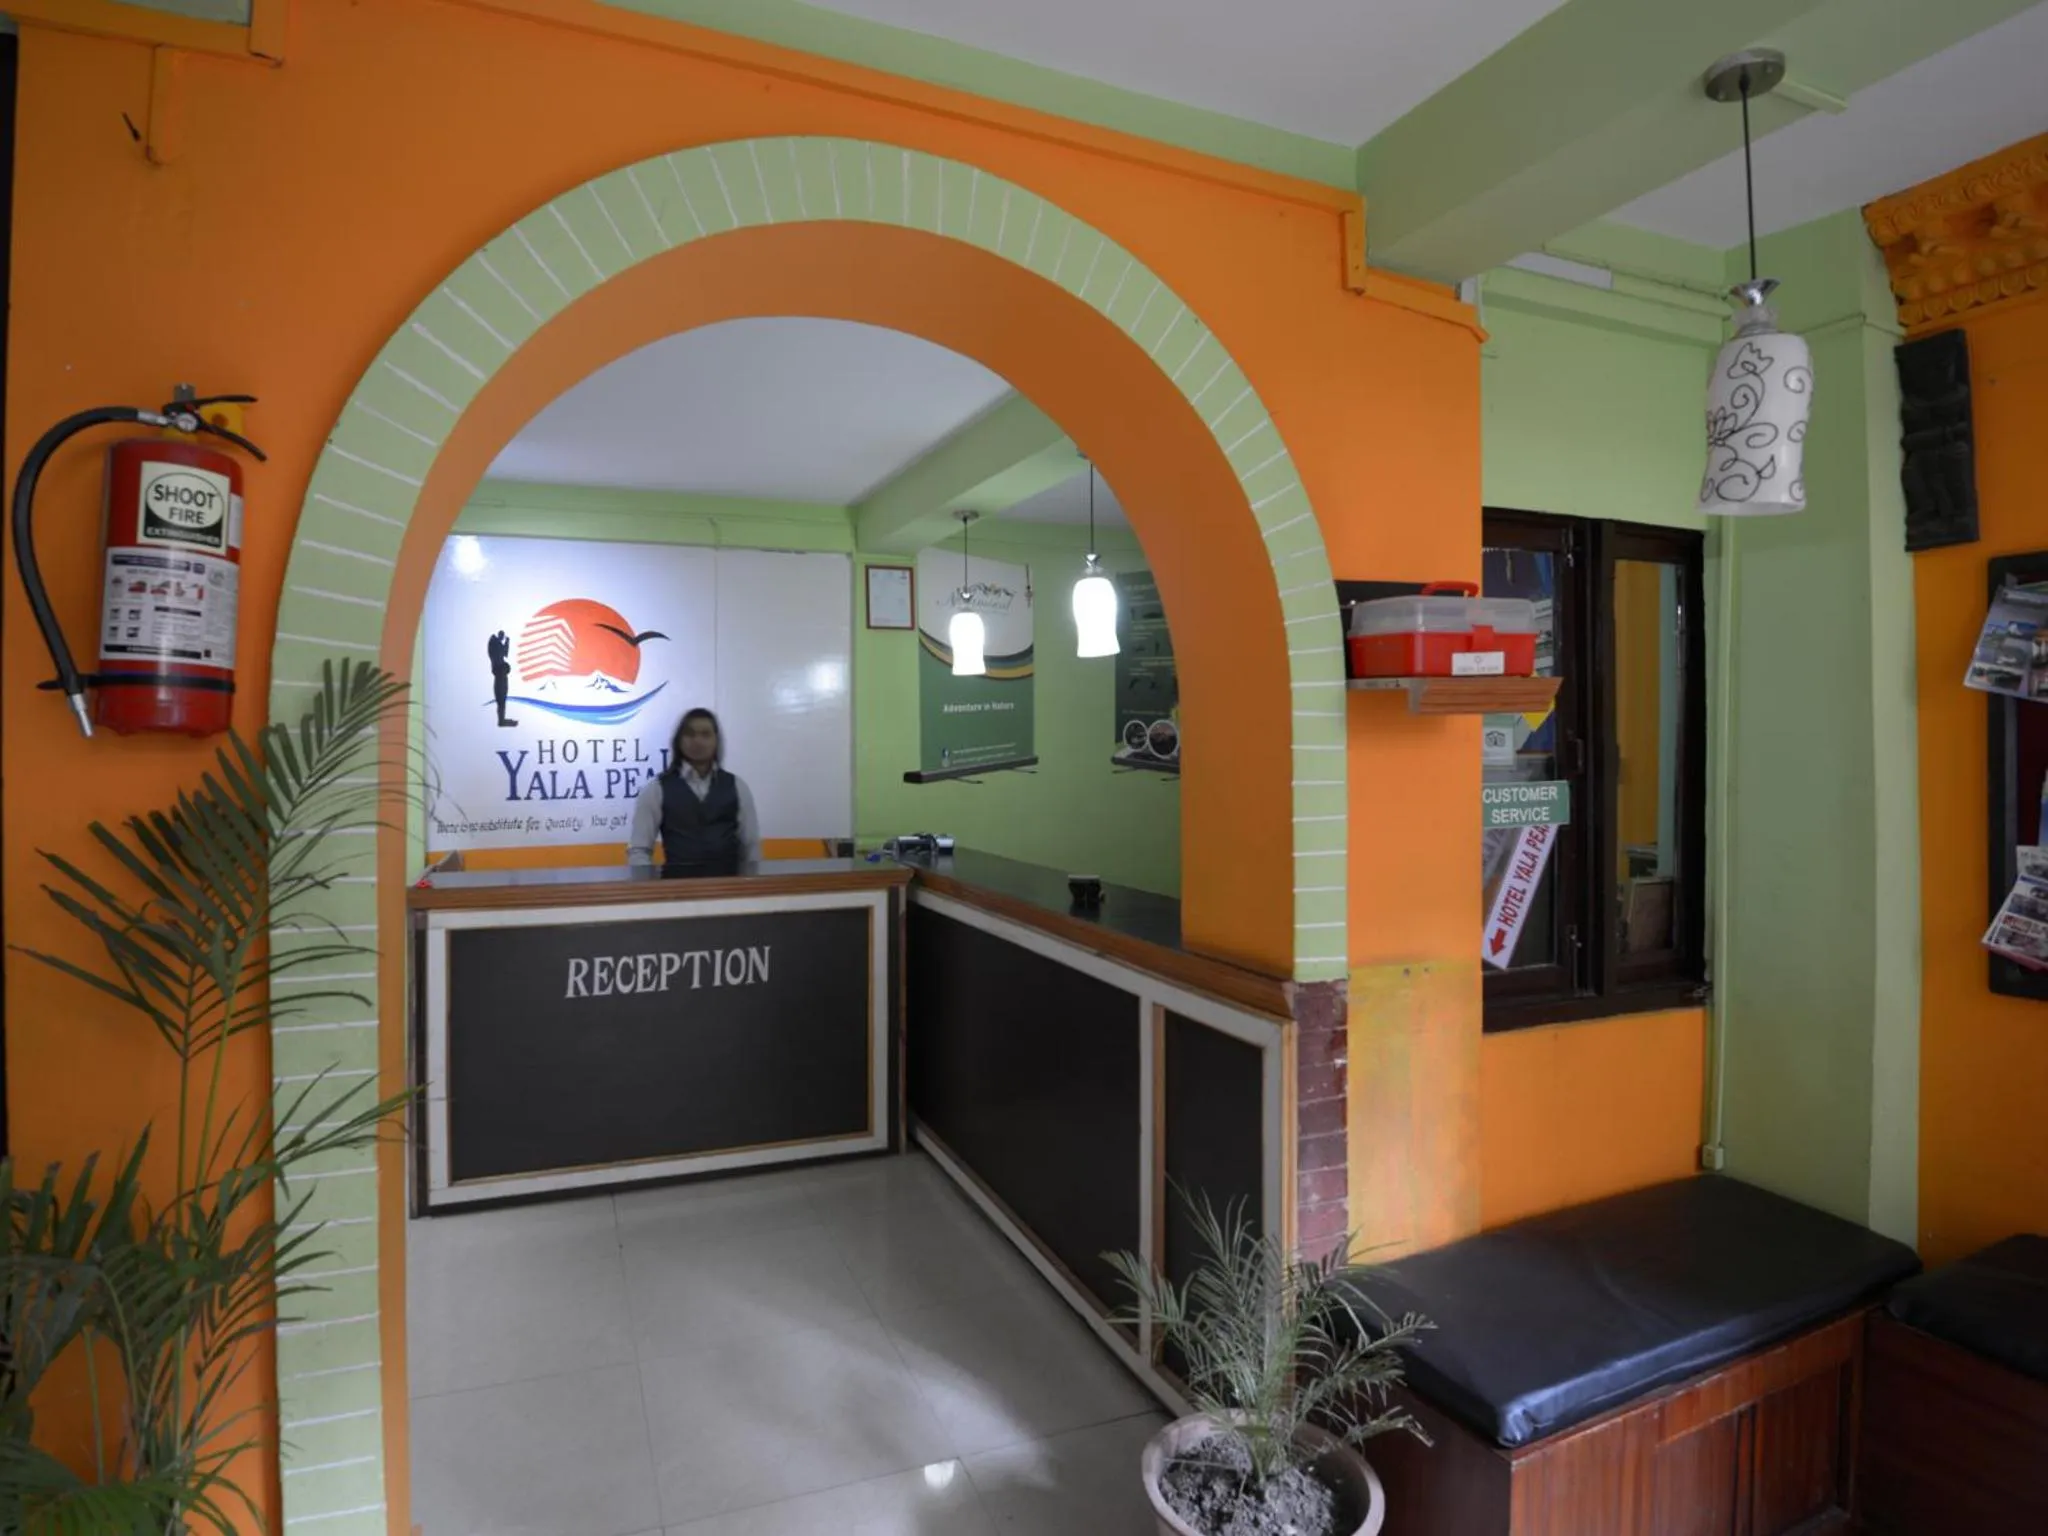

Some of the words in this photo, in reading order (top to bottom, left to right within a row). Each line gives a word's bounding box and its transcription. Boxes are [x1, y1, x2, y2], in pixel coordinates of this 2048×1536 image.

[153, 484, 216, 510] SHOOT
[168, 506, 205, 525] FIRE
[537, 739, 650, 764] HOTEL
[496, 750, 593, 801] YALA
[605, 748, 668, 799] PE
[1482, 786, 1558, 804] CUSTOMER
[1491, 806, 1550, 824] SERVICE
[1497, 885, 1527, 928] HOTEL
[1512, 849, 1540, 884] YALA
[564, 945, 771, 999] RECEPTION
